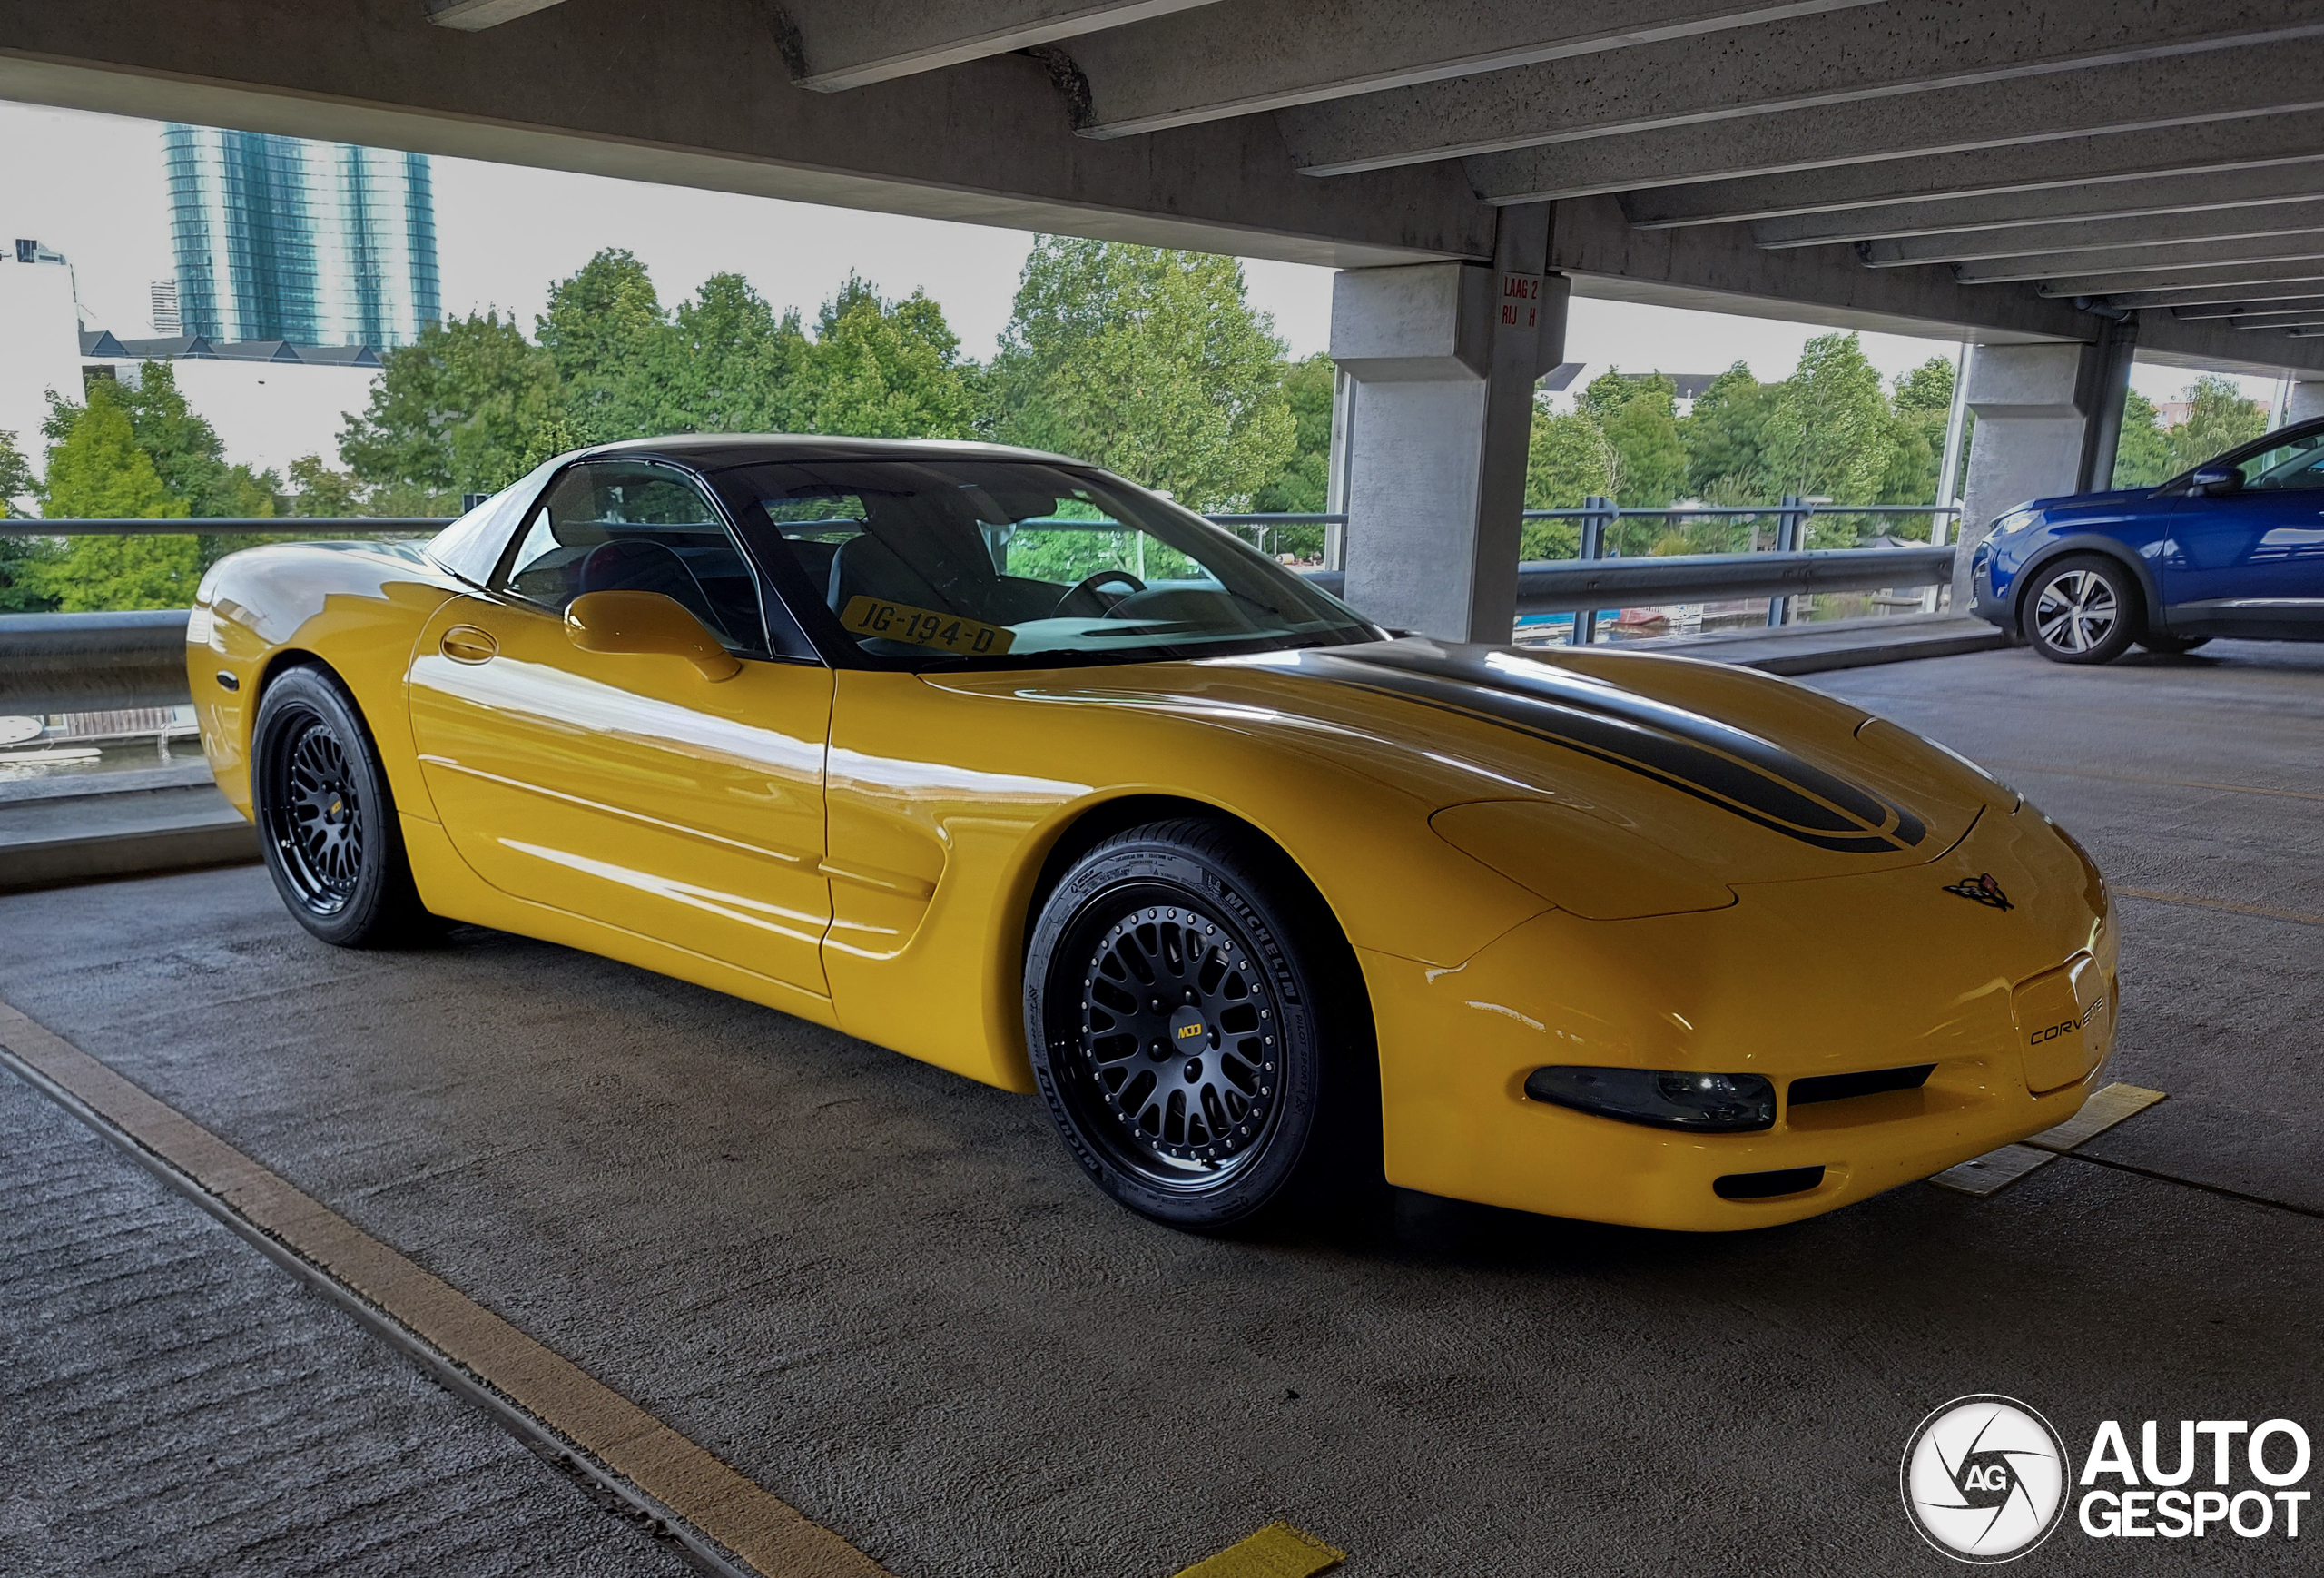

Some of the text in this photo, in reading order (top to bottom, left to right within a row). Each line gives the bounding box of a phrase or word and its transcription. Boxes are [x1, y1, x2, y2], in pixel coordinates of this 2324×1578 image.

[1504, 276, 1539, 300] LAAG 2
[1502, 305, 1536, 327] RIJ H
[857, 603, 996, 654] JG-194-D
[1225, 891, 1297, 998] MICHELIN
[1177, 1023, 1202, 1040] CCW
[1295, 1014, 1306, 1045] PILOT
[2030, 995, 2103, 1046] CORVETTE
[1299, 1050, 1308, 1089] SPORT
[1039, 1073, 1098, 1171] MICHELIN
